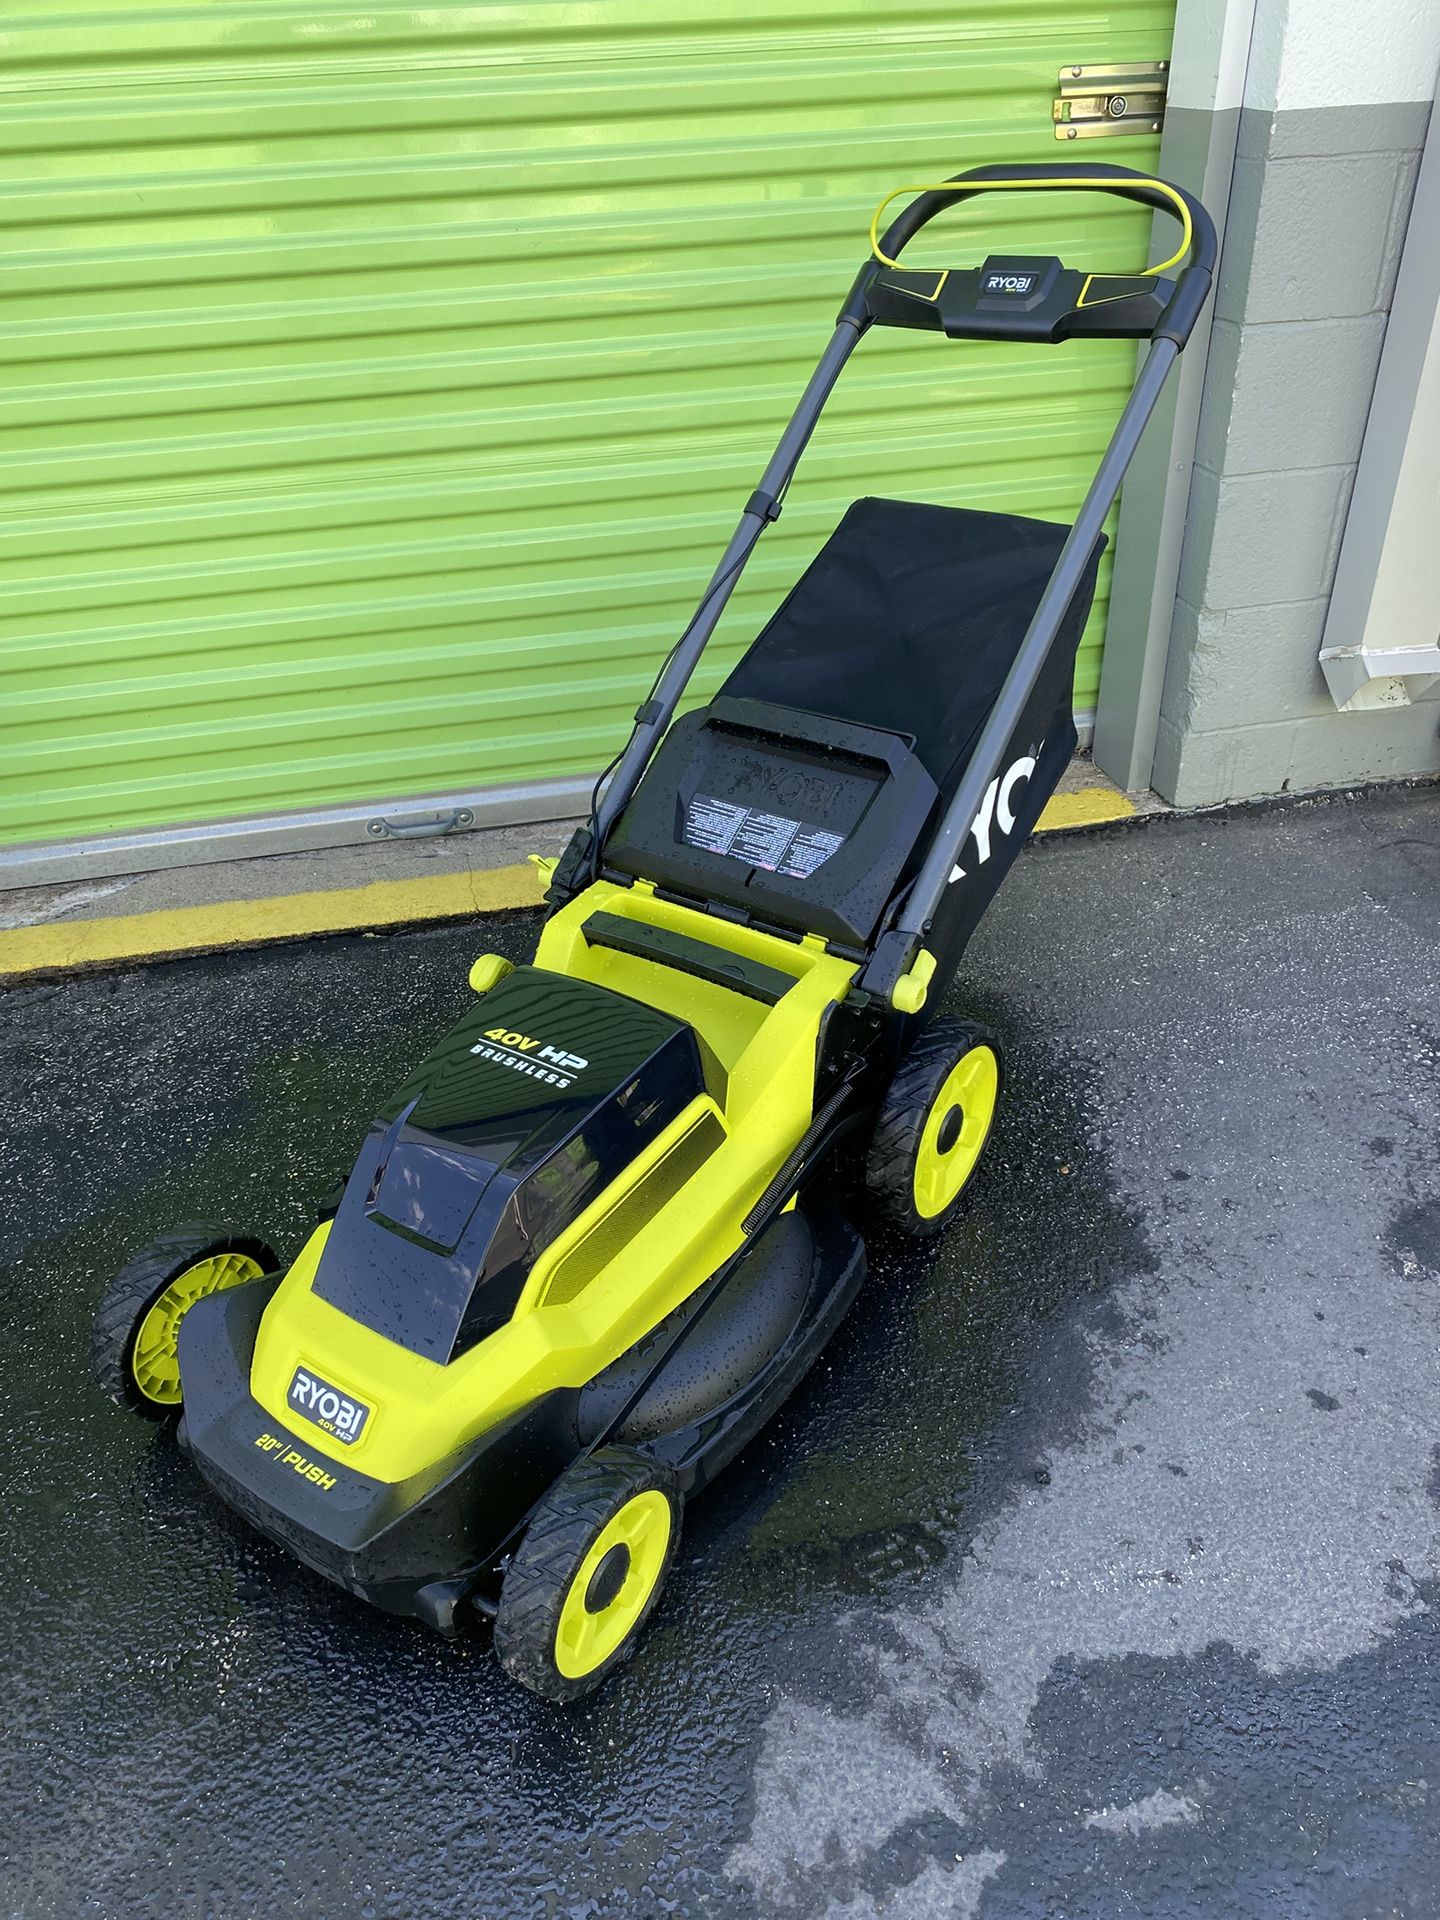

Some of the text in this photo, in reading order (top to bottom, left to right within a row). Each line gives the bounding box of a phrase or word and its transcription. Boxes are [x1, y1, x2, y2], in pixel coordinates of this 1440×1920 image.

[988, 276, 1031, 289] RYOBI
[470, 1044, 571, 1089] BRUSHLESS
[483, 1028, 589, 1069] 40V HP
[292, 1373, 363, 1435] RYOBI
[317, 1418, 353, 1443] 40V HP
[282, 1451, 337, 1491] PUSH
